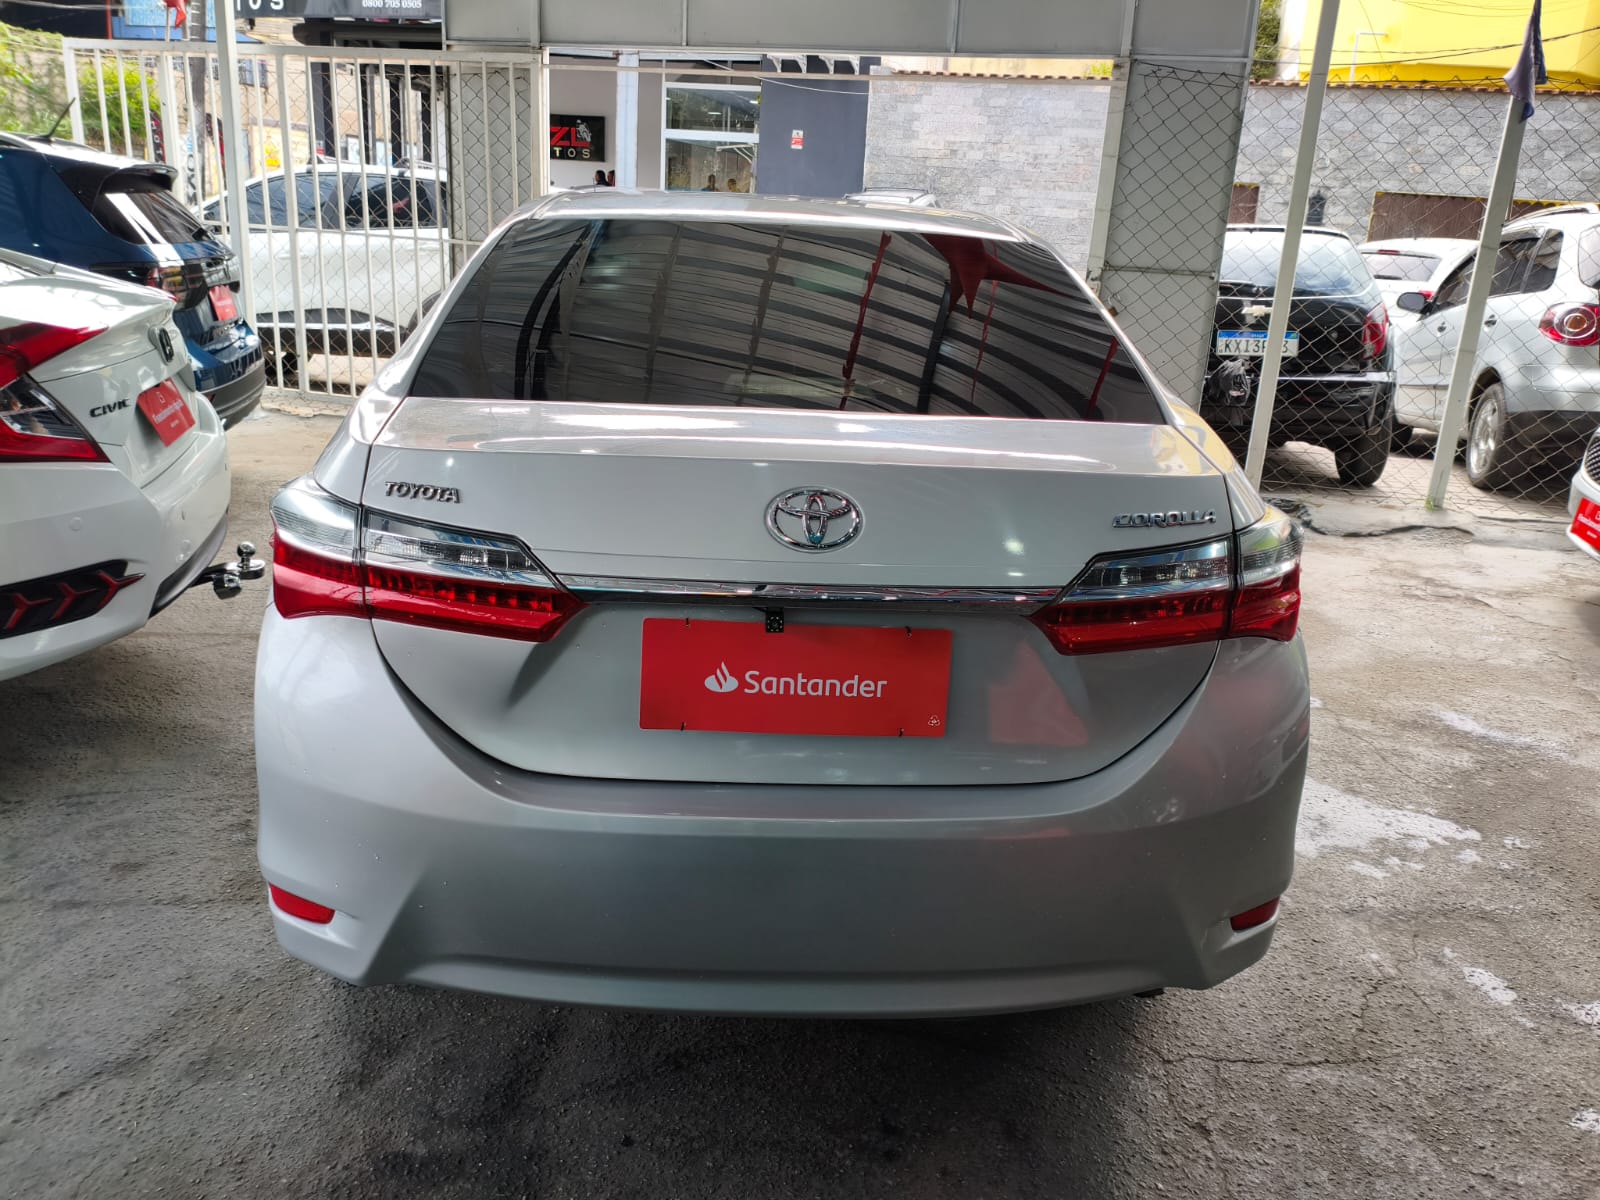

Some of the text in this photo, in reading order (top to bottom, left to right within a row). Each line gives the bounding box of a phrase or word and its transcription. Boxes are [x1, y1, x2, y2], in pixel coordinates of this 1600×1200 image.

[1224, 339, 1289, 353] KXI33
[90, 399, 130, 417] CIVIC
[384, 481, 462, 503] TOYOTA
[1112, 509, 1217, 528] COROLLA
[744, 670, 887, 698] Santander
